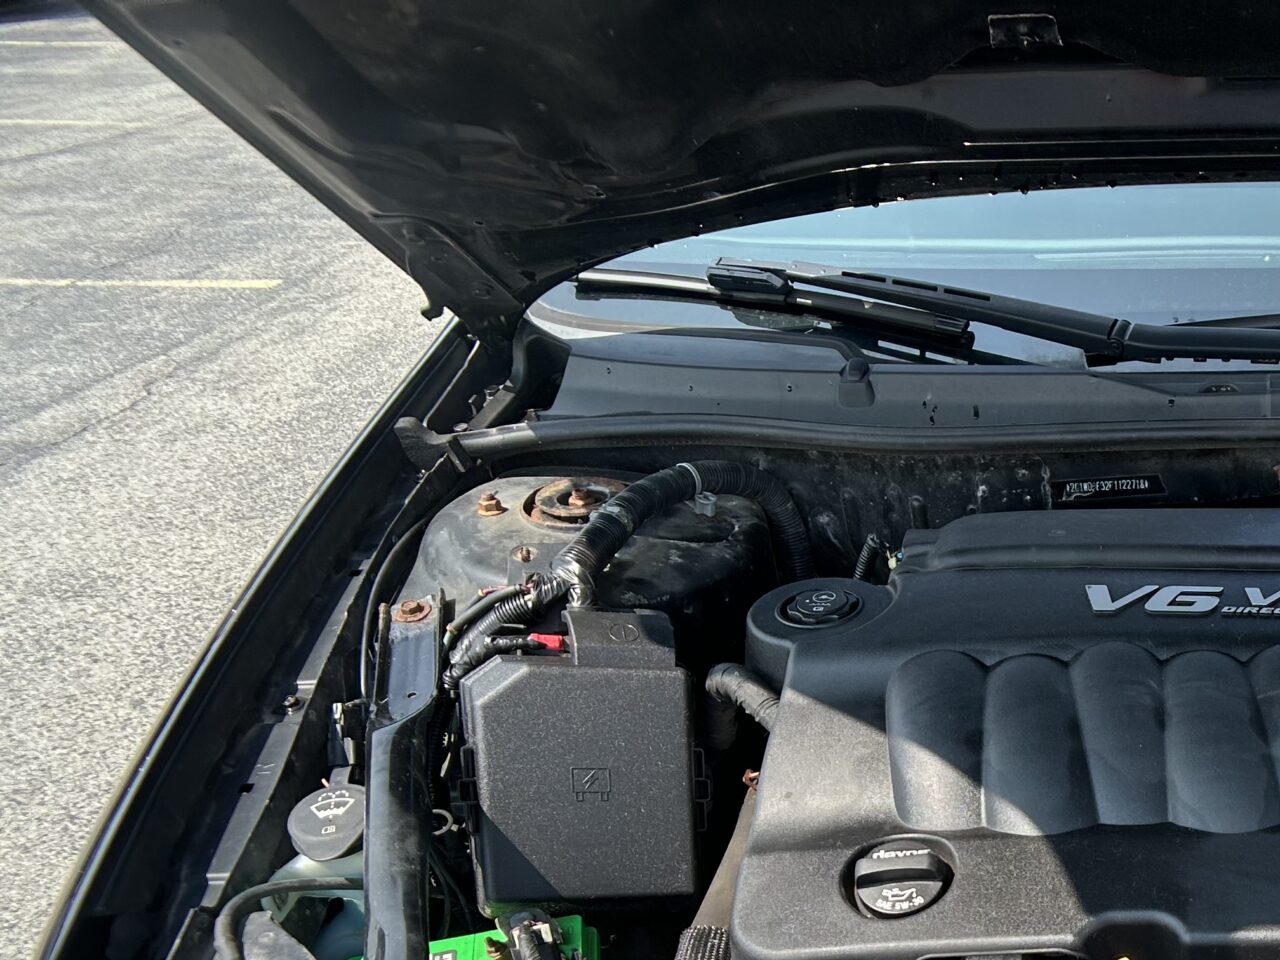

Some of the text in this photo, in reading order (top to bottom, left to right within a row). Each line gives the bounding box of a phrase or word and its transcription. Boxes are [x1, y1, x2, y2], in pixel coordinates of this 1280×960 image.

[1071, 480, 1145, 492] 2G1WDE32F1122718
[1085, 585, 1224, 612] V6
[875, 896, 924, 910] SAE 5W-30
